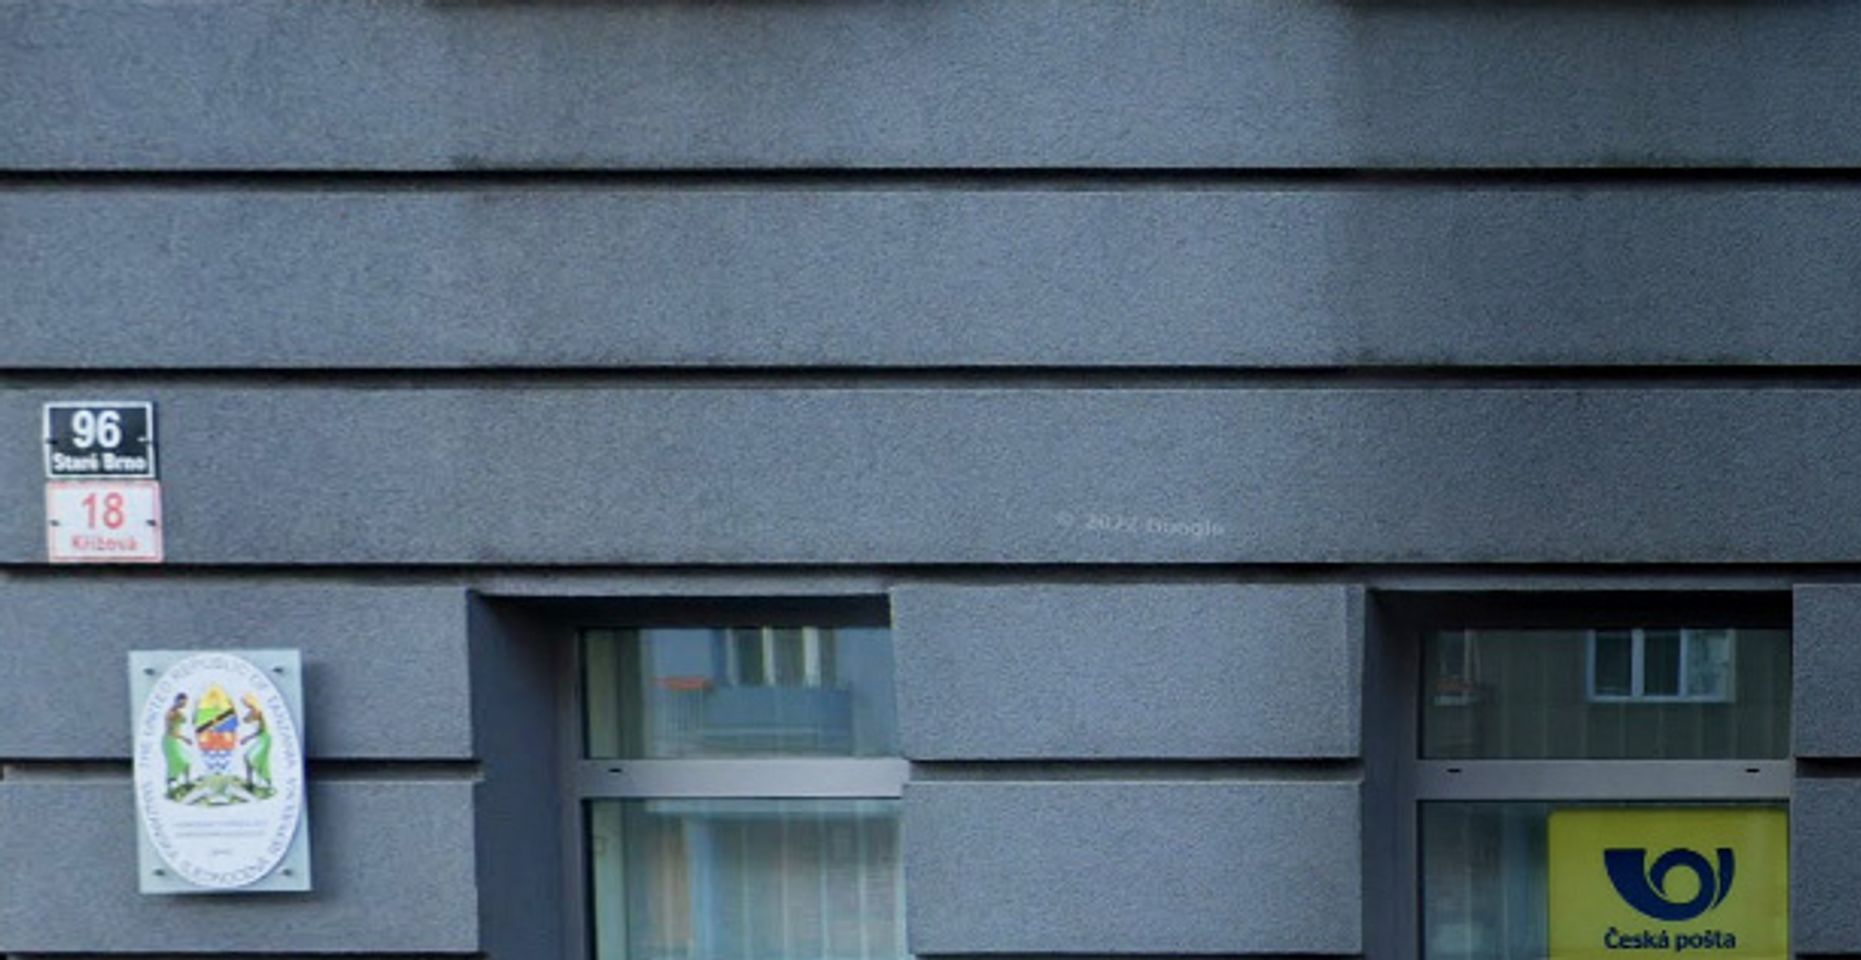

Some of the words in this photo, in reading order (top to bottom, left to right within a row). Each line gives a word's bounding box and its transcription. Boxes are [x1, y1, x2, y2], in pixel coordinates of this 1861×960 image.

[71, 409, 122, 448] 96
[53, 452, 98, 471] Staré
[102, 452, 147, 471] Brno
[81, 492, 124, 529] 18
[1603, 927, 1669, 950] Česká
[1675, 928, 1737, 952] pošta
